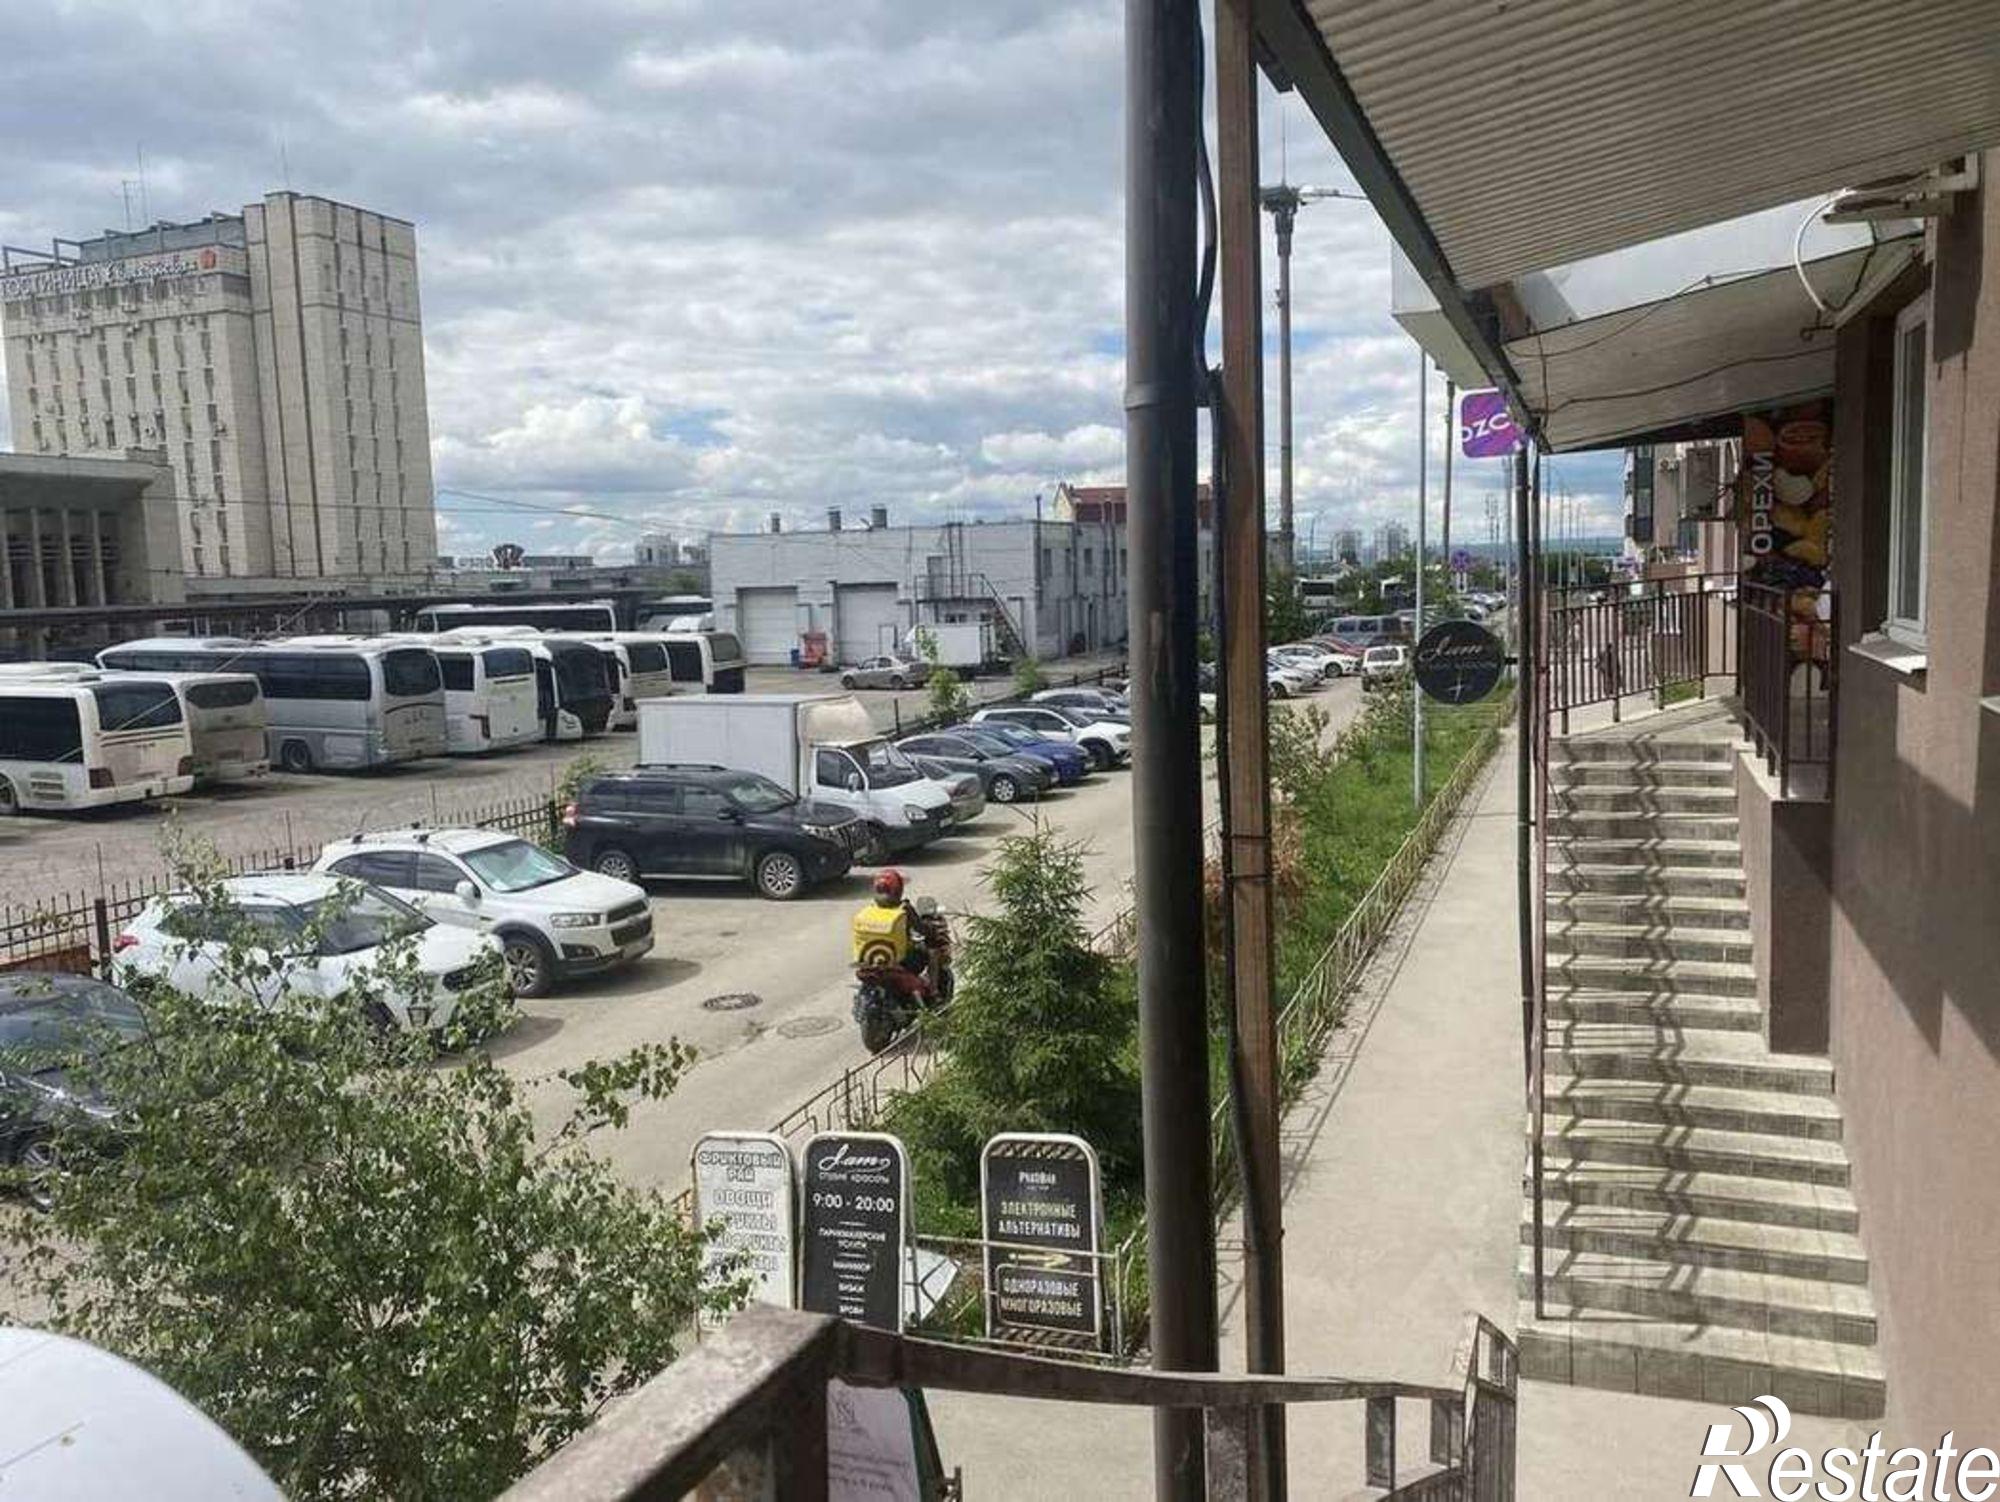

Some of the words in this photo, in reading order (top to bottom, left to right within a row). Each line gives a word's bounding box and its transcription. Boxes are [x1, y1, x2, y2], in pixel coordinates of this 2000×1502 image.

[1751, 451, 1773, 555] ОРЕХИ
[699, 1151, 783, 1169] ФРУКТОВЫЙ
[713, 1189, 775, 1210] ОВОЩИ
[813, 1192, 844, 1209] 9:00
[855, 1195, 895, 1213] 20:00
[1001, 1201, 1078, 1219] ЭЛЕКТРОННЫЕ
[998, 1219, 1081, 1239] АЛЬТЕРНАТИВЫ
[1003, 1278, 1080, 1298] ОДНОРАЗОВЫЕ
[1000, 1297, 1083, 1318] МНОГОРАЗОВЫЕ
